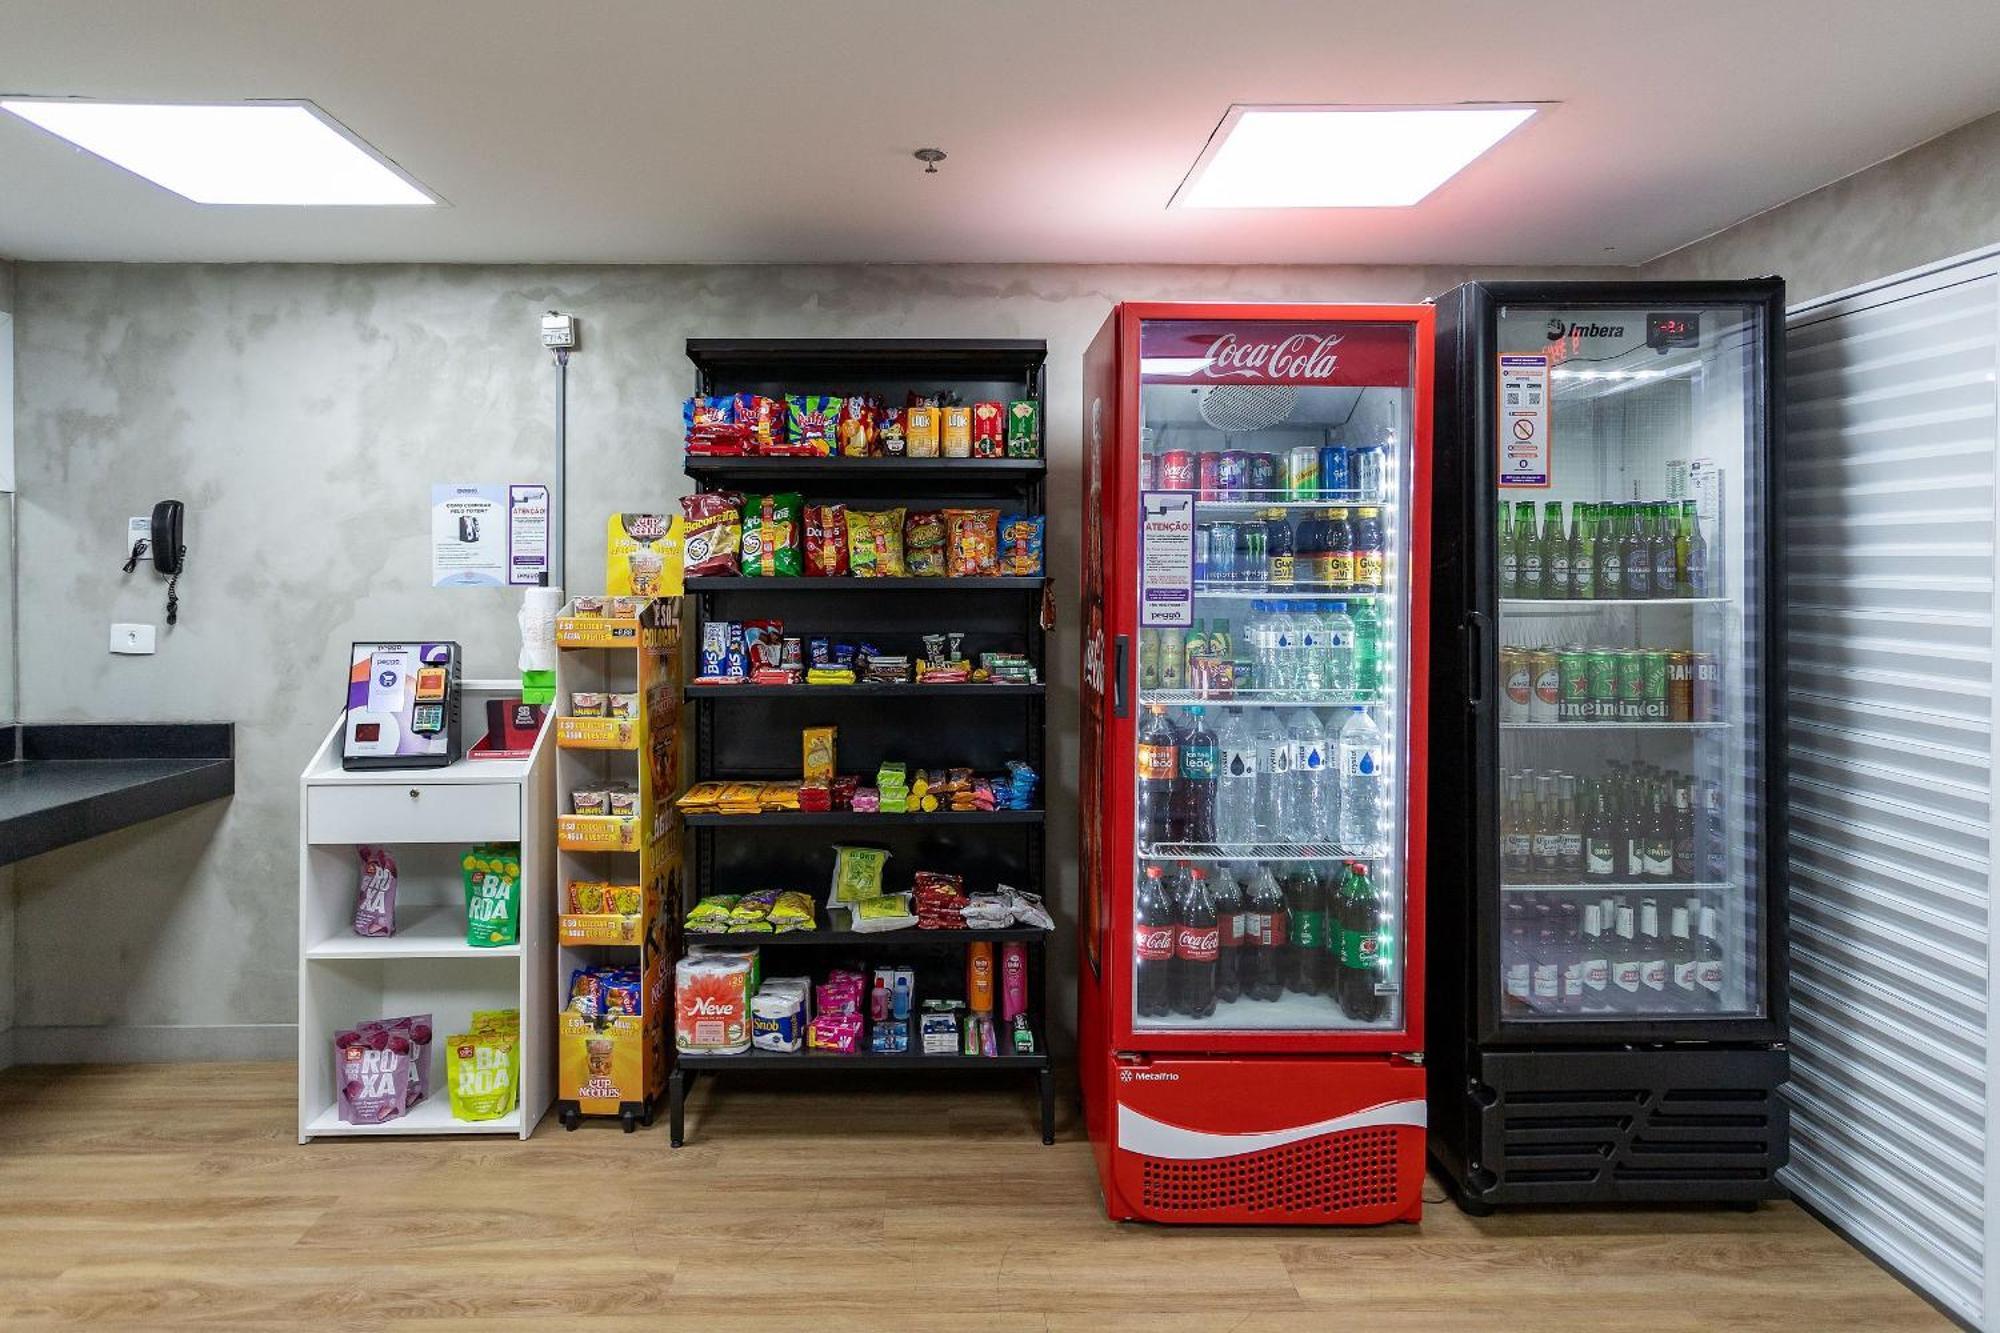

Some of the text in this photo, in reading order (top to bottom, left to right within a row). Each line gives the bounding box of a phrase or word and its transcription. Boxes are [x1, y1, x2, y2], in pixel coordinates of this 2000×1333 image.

[1568, 322, 1624, 338] Imbera
[1203, 332, 1344, 378] Coca-Cola
[685, 997, 733, 1016] Neve
[754, 1018, 779, 1031] Snob
[361, 1049, 398, 1073] RO
[588, 1079, 611, 1089] CUP
[1135, 1072, 1180, 1081] Metalfrio
[359, 1072, 396, 1098] XA
[578, 1088, 620, 1097] NOODLES
